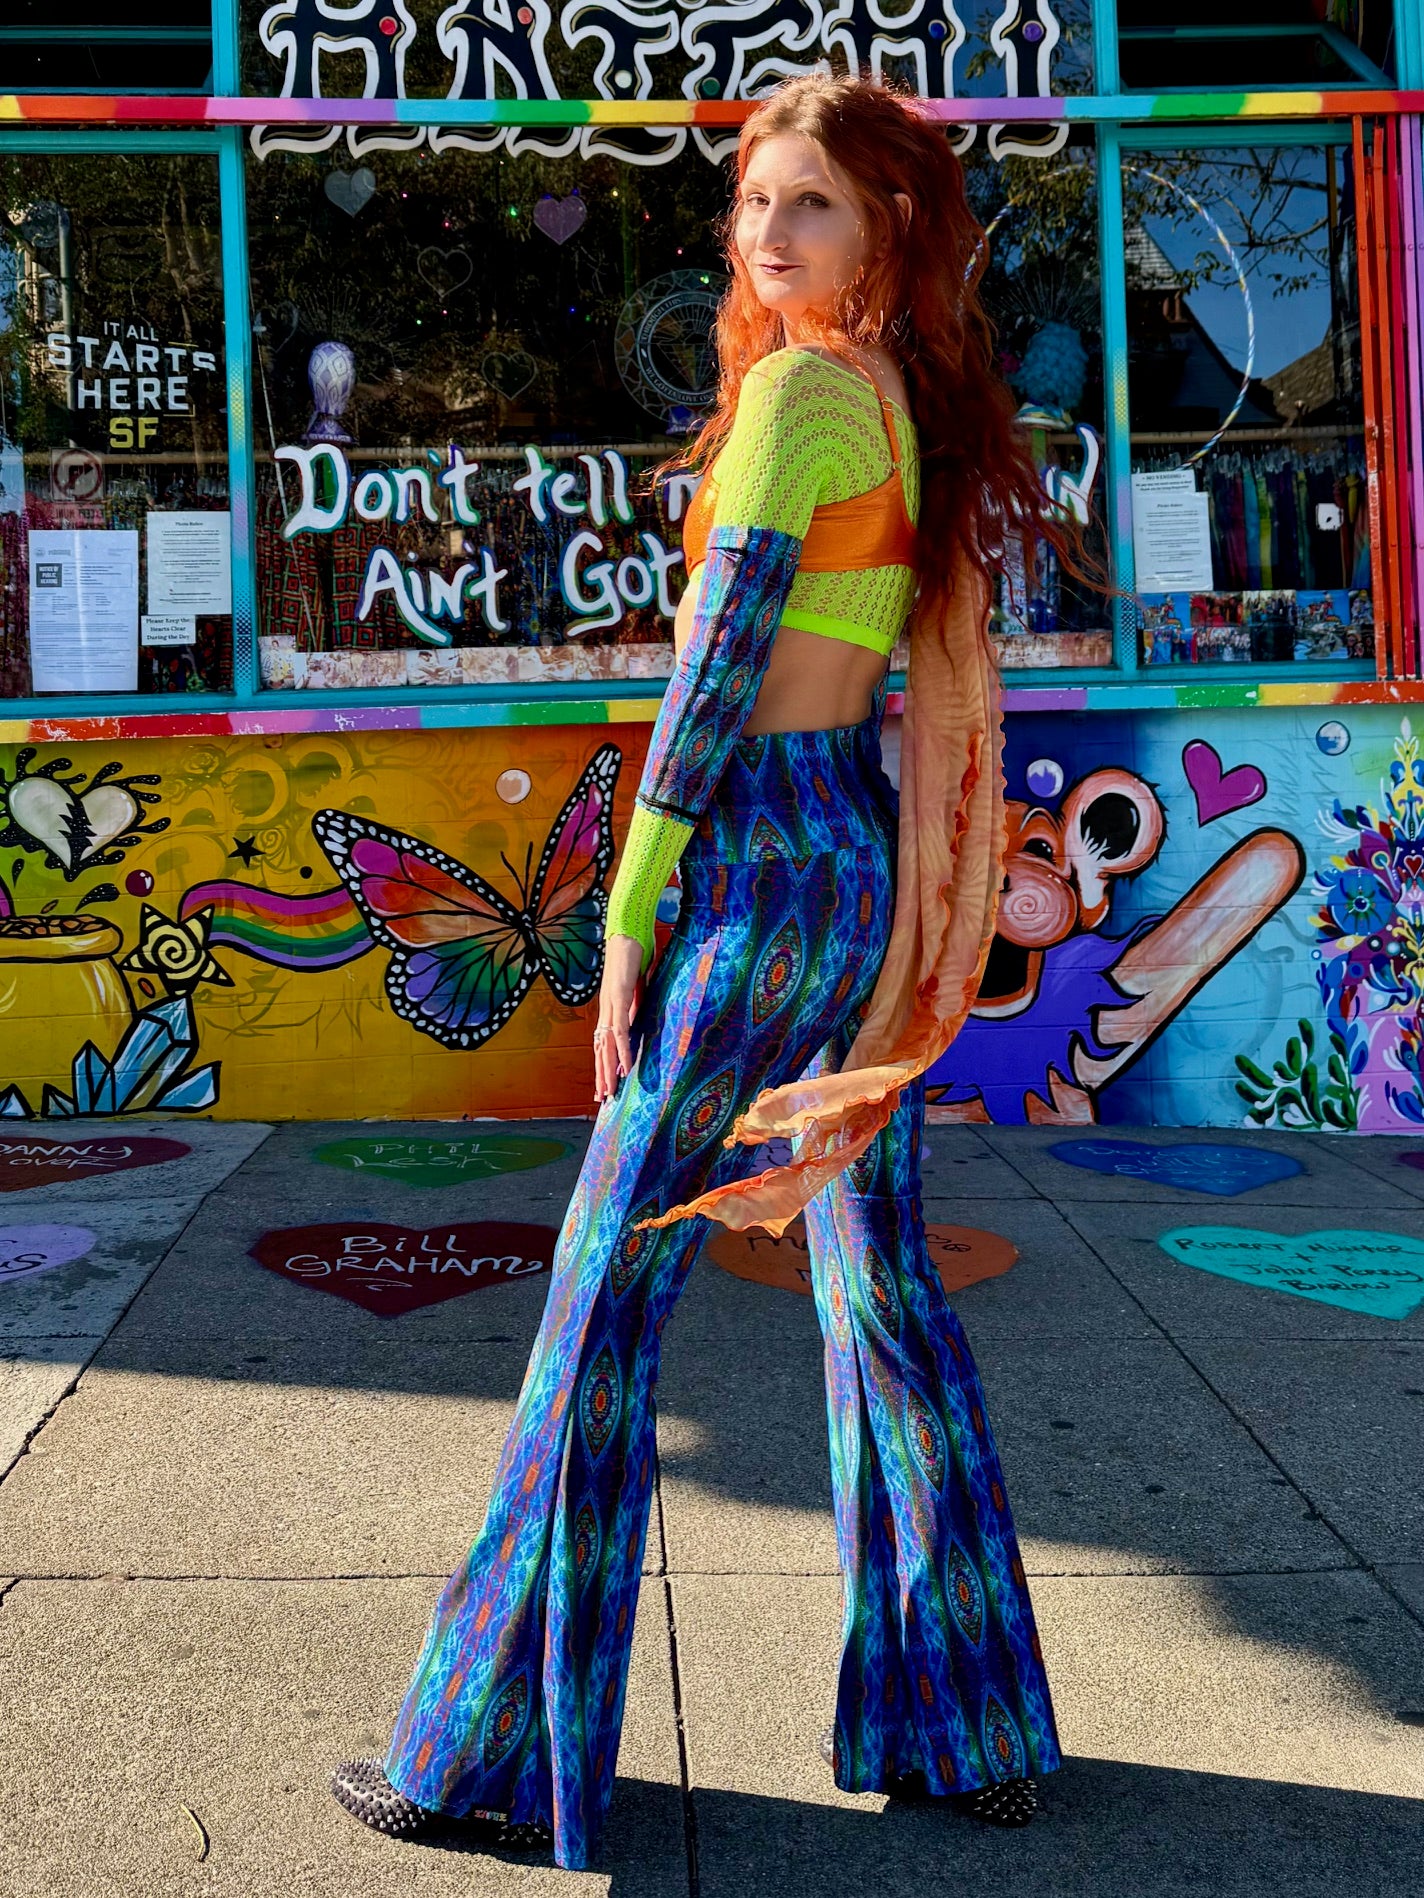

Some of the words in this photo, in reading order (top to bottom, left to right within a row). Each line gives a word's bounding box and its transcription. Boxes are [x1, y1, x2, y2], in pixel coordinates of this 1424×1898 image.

[104, 321, 120, 336] IT
[126, 324, 159, 342] ALL
[47, 333, 216, 373] STARTS
[77, 376, 189, 410] HERE
[109, 416, 159, 449] SF
[273, 443, 481, 541] Don't
[512, 443, 635, 528] tell
[559, 527, 685, 639] Got
